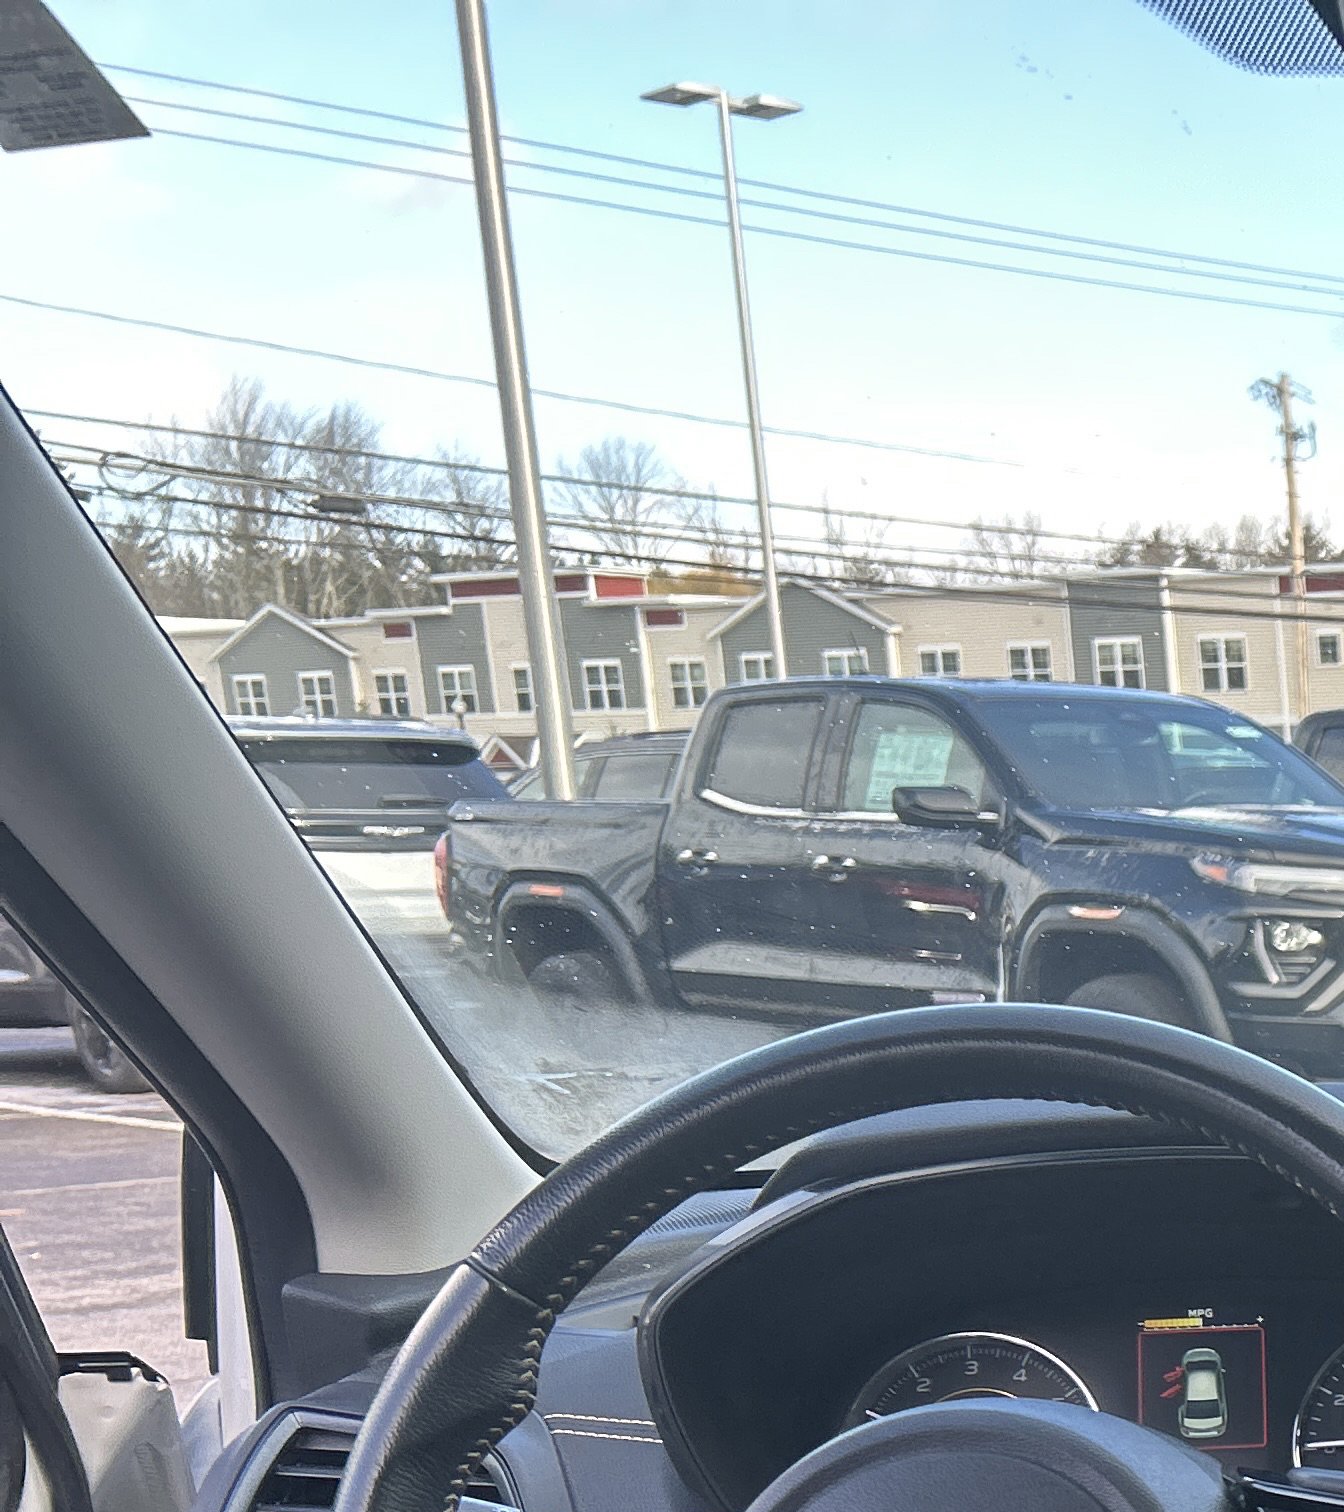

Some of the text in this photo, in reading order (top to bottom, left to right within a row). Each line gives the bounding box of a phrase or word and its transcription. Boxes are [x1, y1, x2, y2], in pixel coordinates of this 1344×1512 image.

[1187, 1308, 1214, 1318] MPG
[965, 1361, 979, 1376] 3
[1013, 1369, 1028, 1382] 4
[916, 1377, 932, 1392] 2
